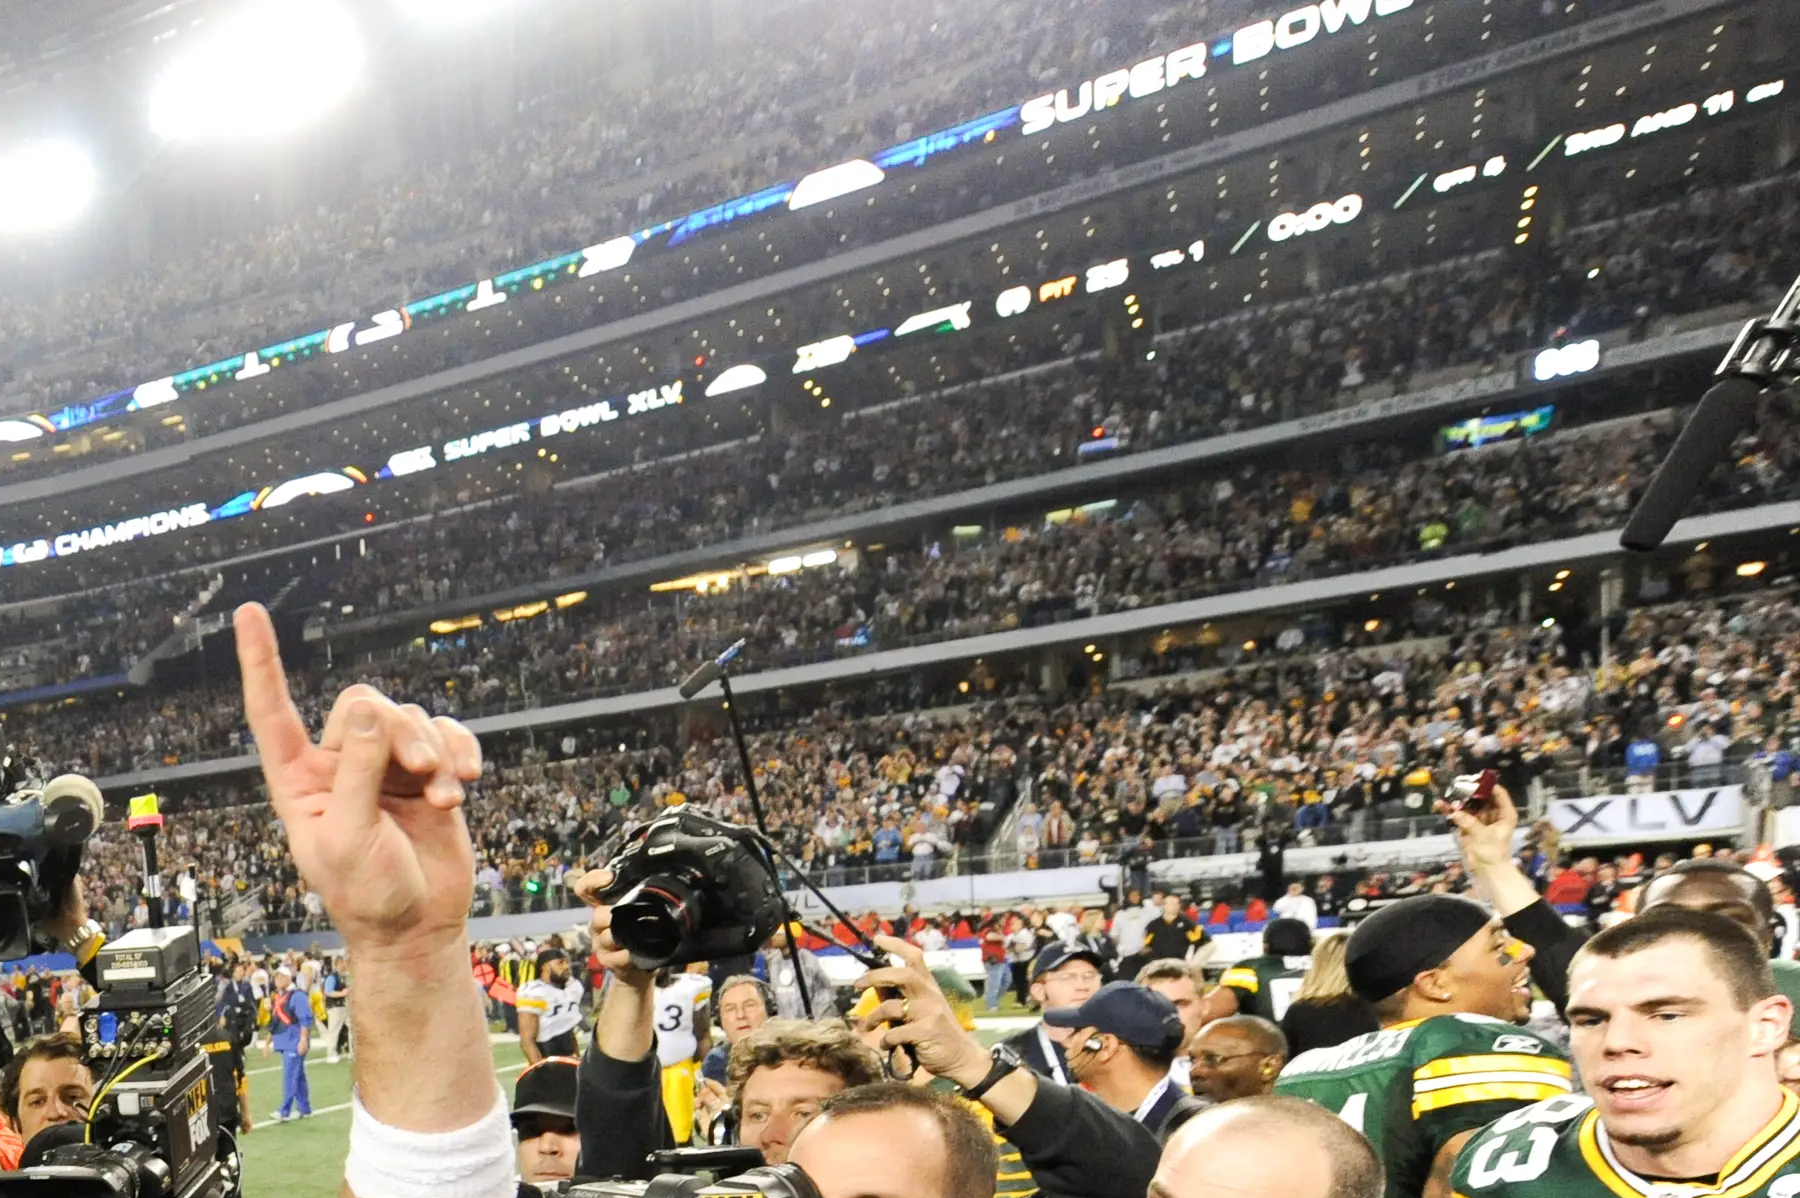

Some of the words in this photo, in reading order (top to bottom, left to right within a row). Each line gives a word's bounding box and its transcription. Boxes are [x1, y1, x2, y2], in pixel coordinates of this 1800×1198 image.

[1020, 42, 1207, 136] SUPER
[1267, 194, 1363, 242] 0:00
[443, 422, 530, 461] SUPER
[540, 401, 619, 437] BOWL
[627, 380, 683, 415] XLV
[54, 503, 211, 556] CHAMPIONS
[1567, 790, 1721, 833] XLV
